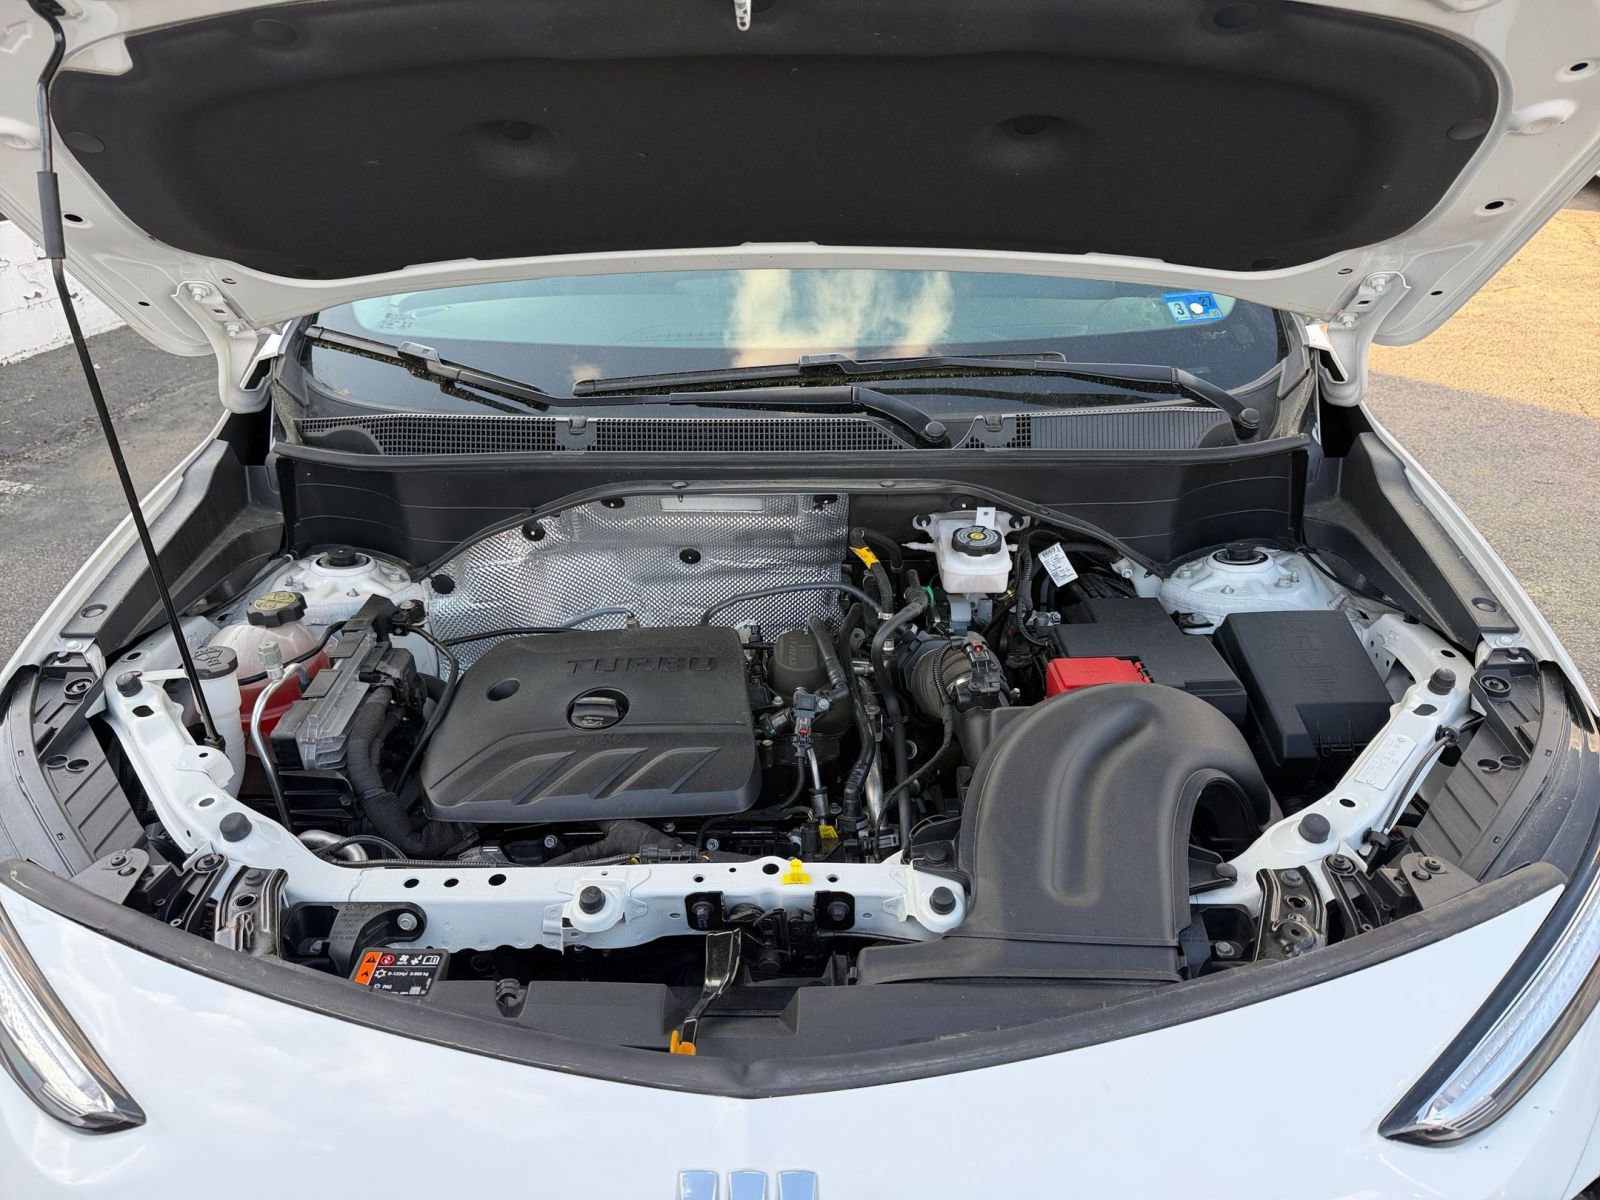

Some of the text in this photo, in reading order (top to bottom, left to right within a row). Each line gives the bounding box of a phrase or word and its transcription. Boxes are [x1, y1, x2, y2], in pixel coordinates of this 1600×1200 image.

[1199, 296, 1212, 307] 27
[1173, 303, 1185, 315] 3
[567, 656, 718, 674] TURBO
